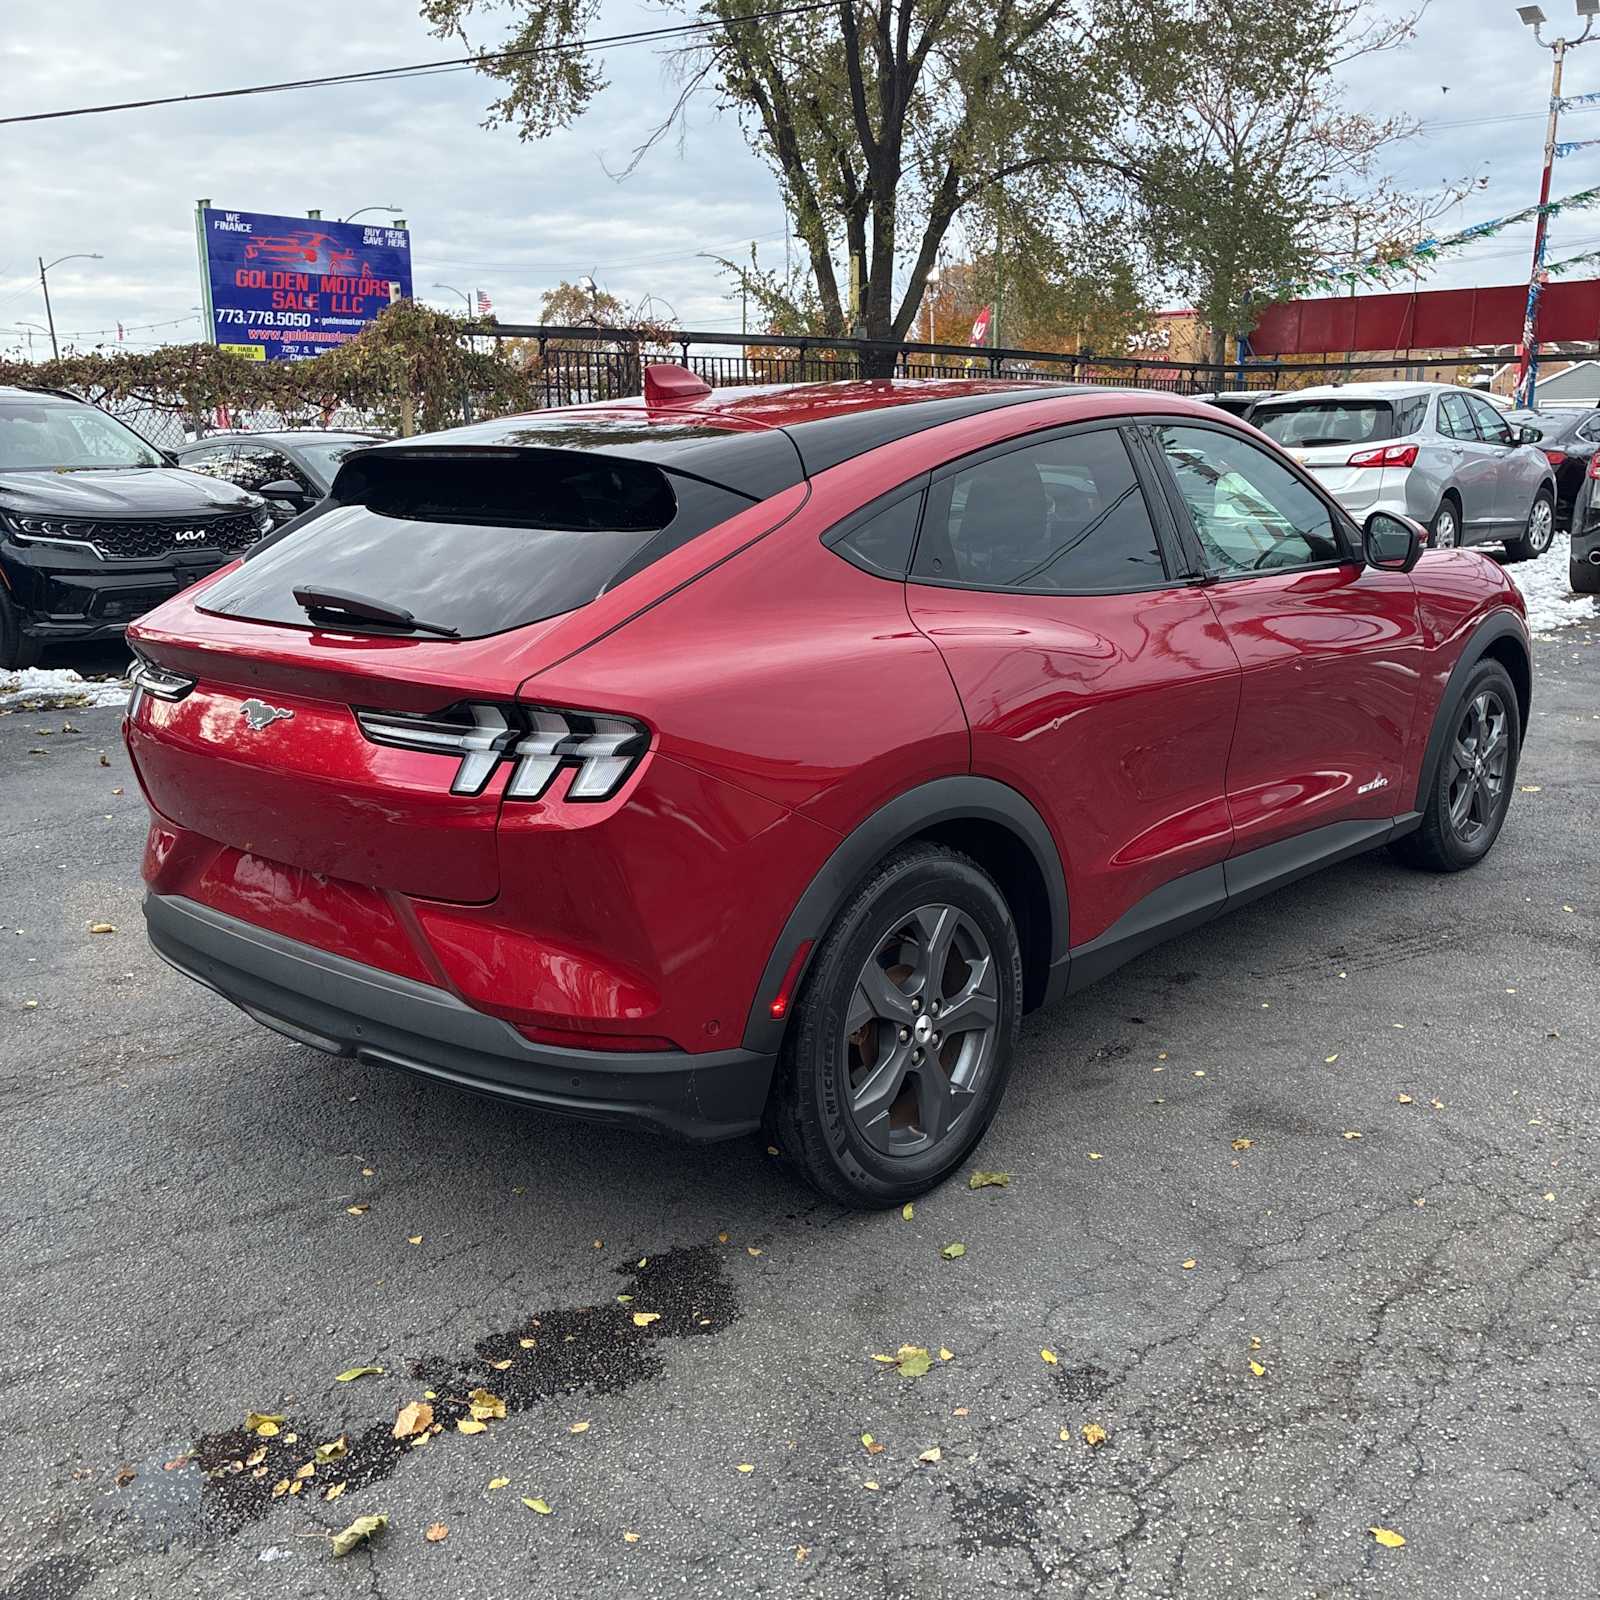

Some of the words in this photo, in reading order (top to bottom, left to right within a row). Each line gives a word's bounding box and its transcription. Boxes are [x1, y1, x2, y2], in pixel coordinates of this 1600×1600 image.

[225, 212, 241, 222] WE
[214, 220, 253, 233] FINANCE
[364, 227, 381, 237] BUY
[385, 230, 405, 239] HERE
[362, 236, 384, 246] SAVE
[387, 238, 408, 248] HERE
[235, 269, 309, 291] GOLDEN
[320, 275, 390, 298] MOTORS
[271, 291, 319, 311] SALE
[331, 294, 364, 313] LLC
[215, 309, 311, 327] 773.778.5050
[281, 345, 300, 353] 7257
